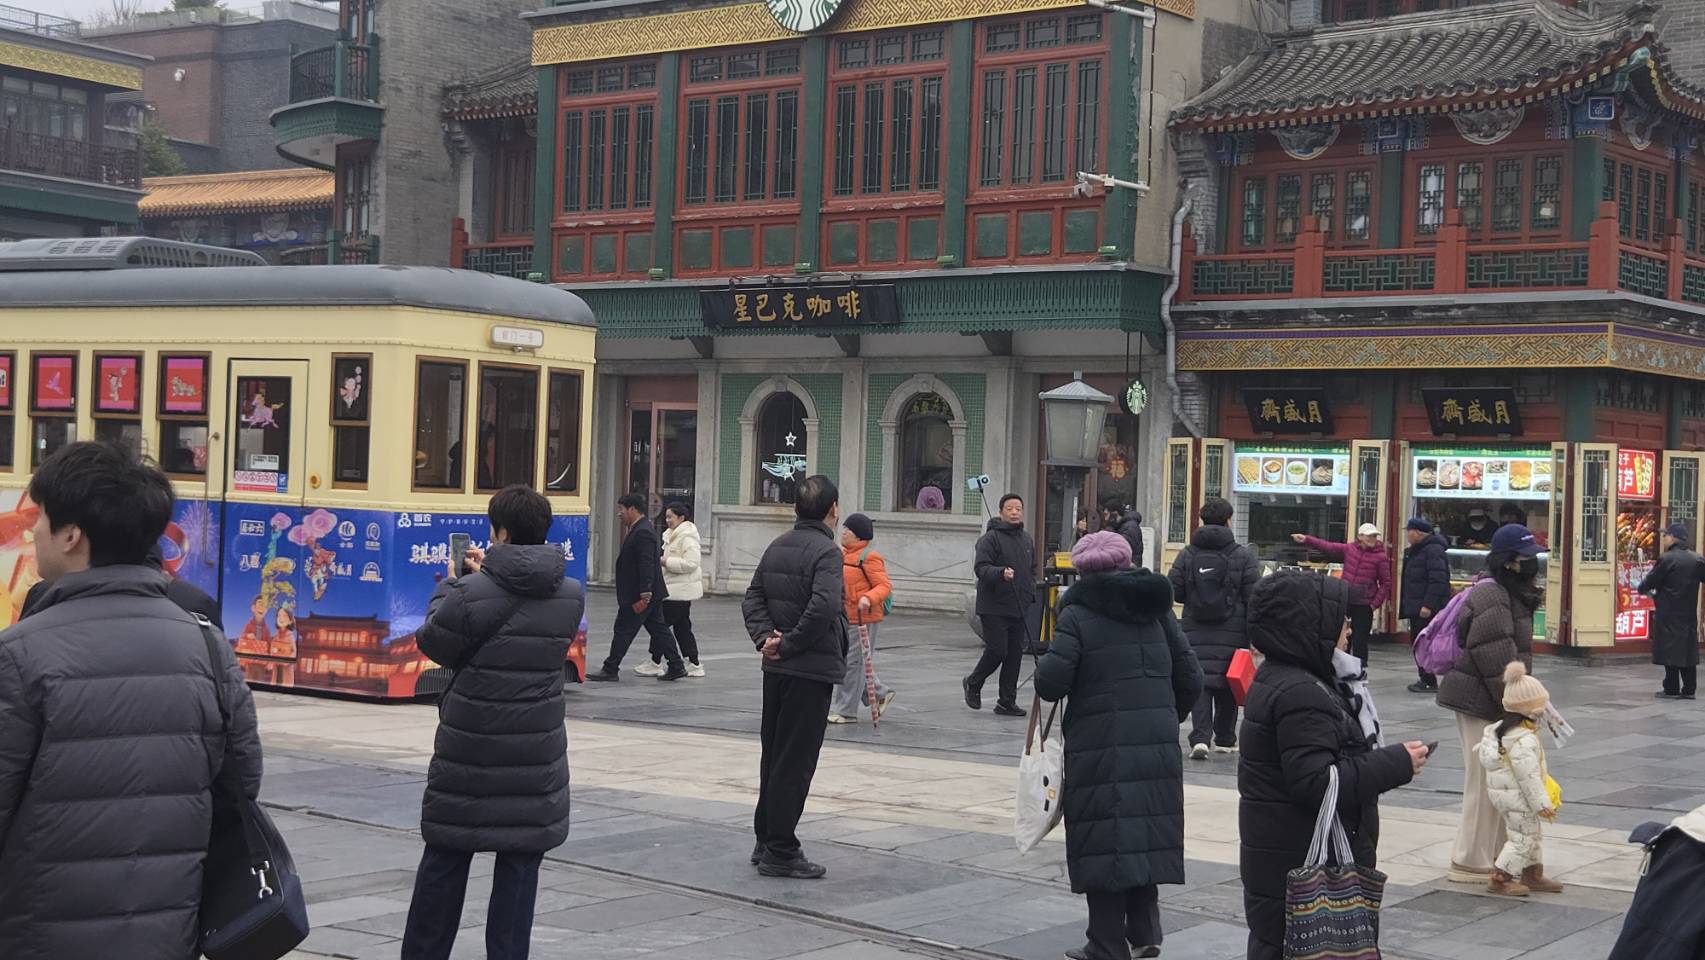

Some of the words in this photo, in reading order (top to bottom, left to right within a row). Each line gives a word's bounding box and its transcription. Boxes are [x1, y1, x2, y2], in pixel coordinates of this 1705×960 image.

[733, 291, 861, 322] 星巴克咖啡
